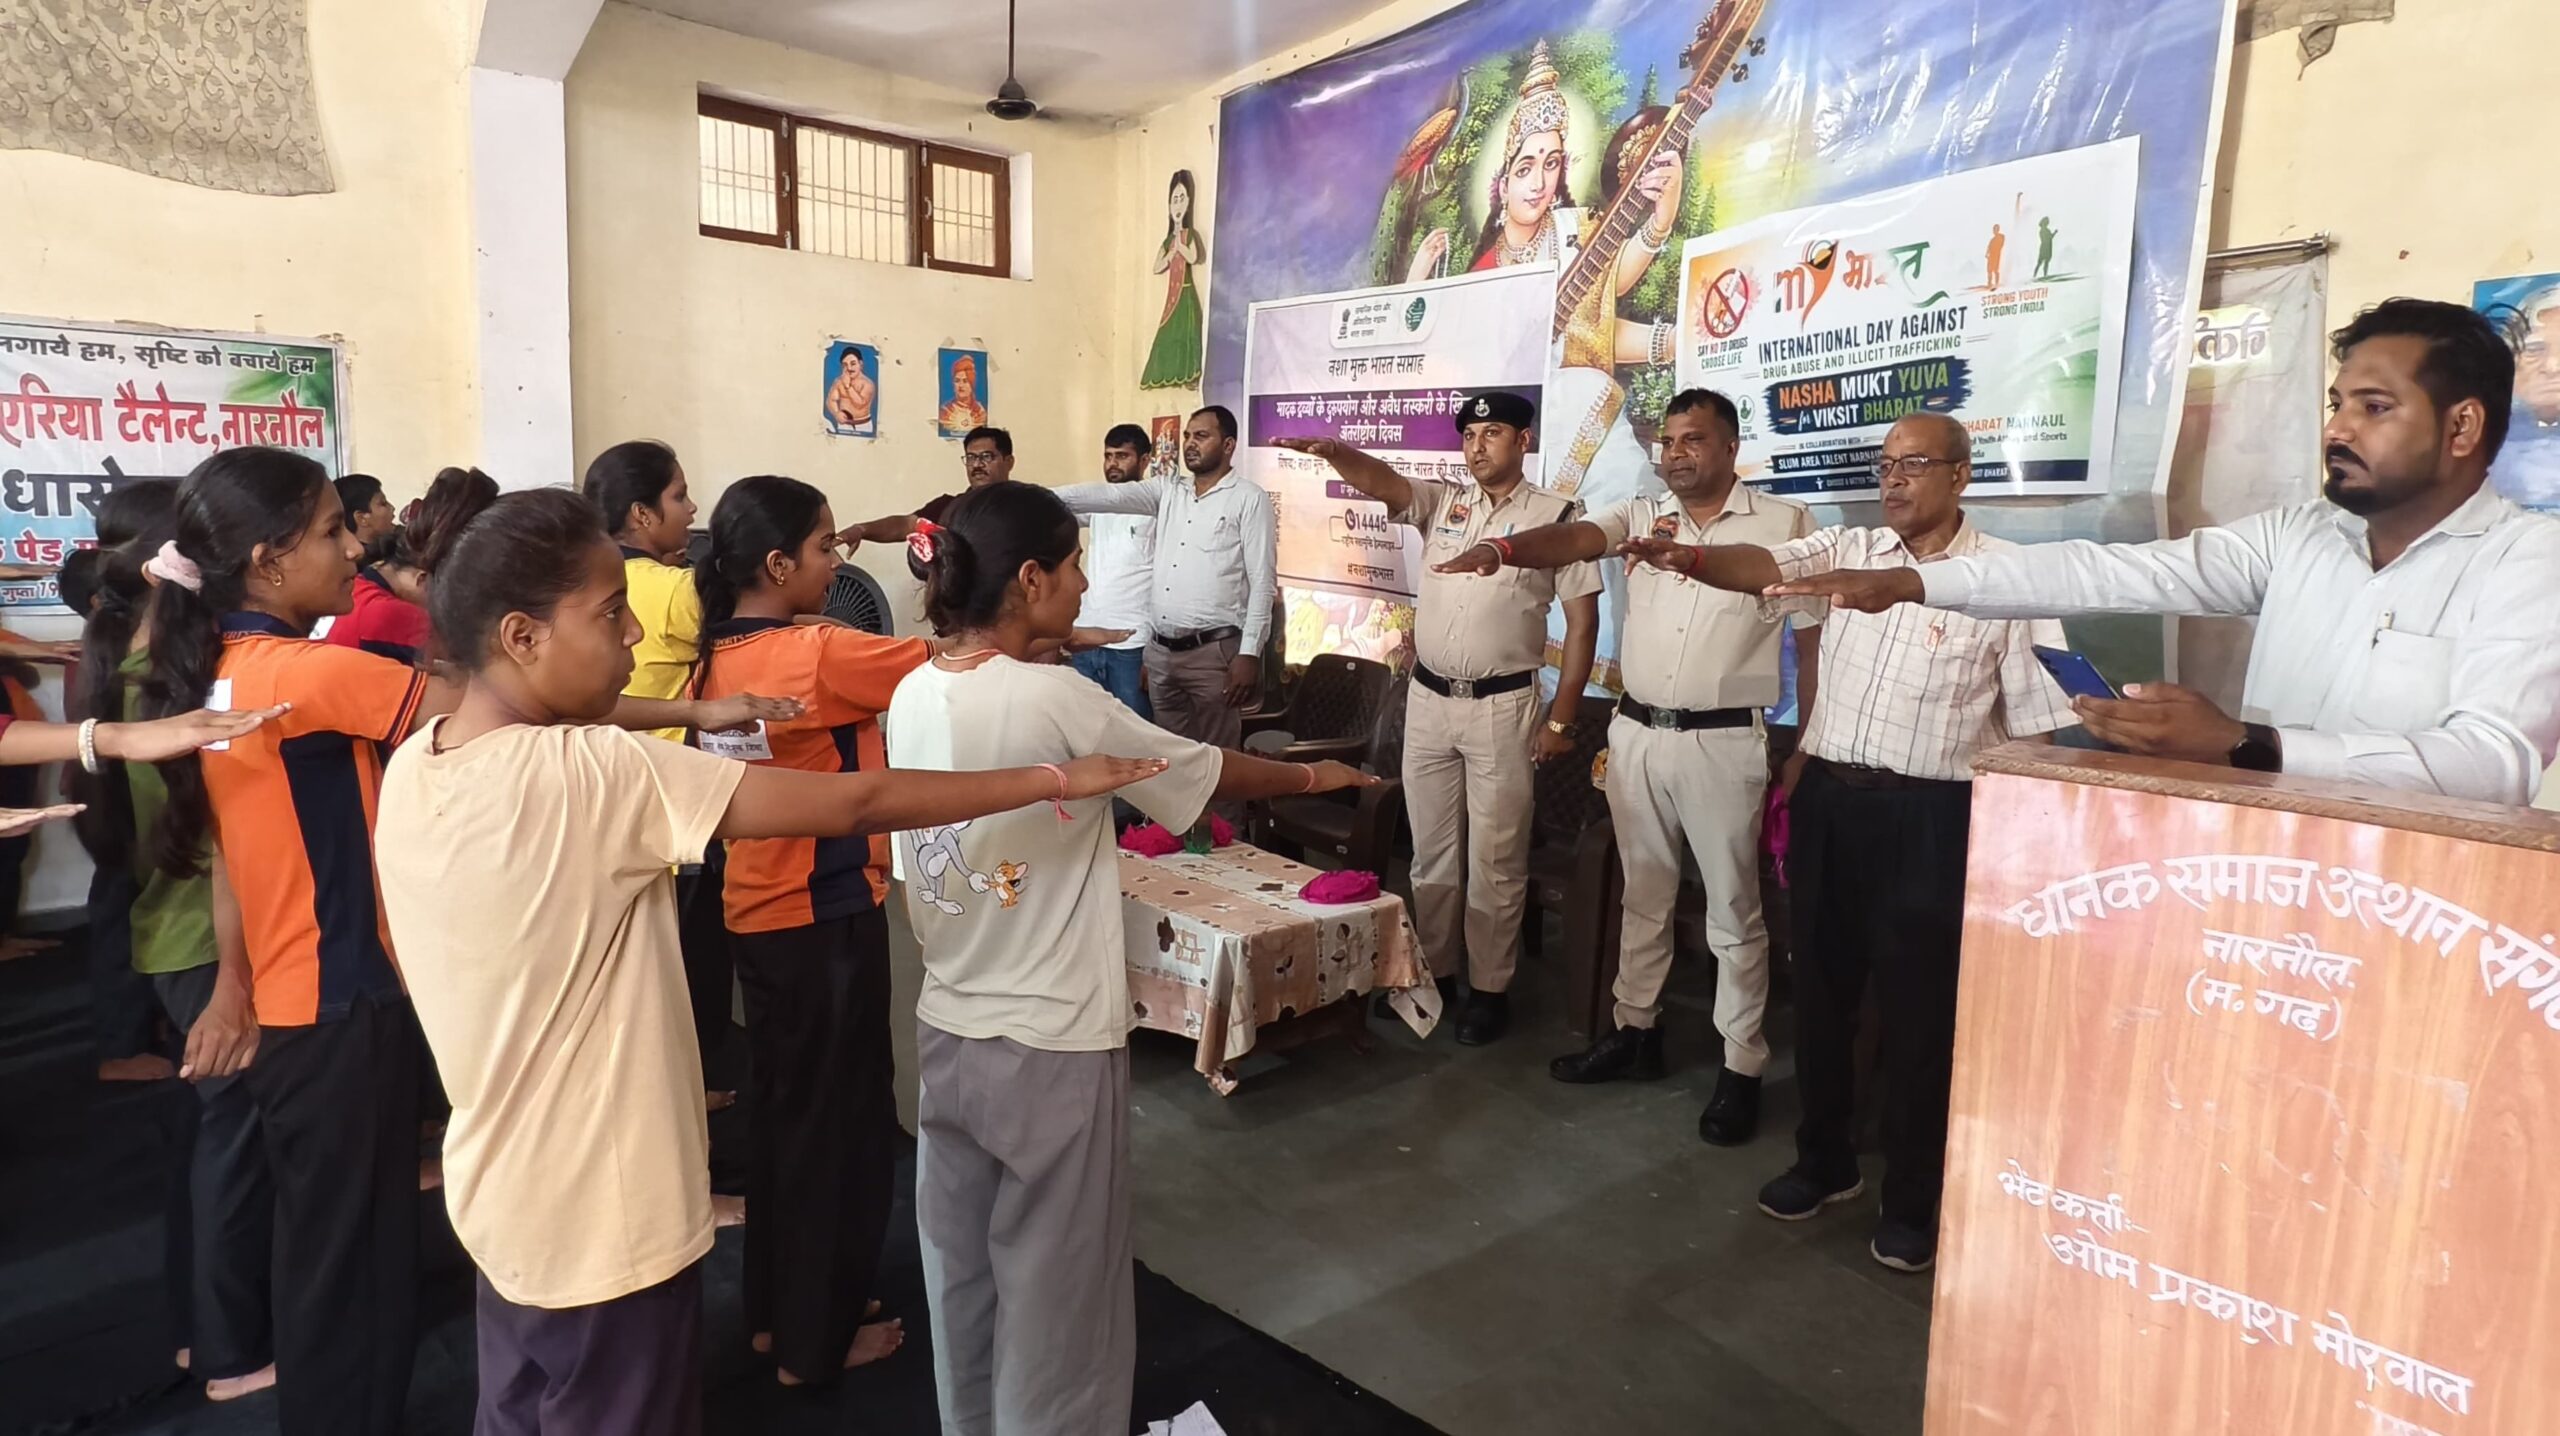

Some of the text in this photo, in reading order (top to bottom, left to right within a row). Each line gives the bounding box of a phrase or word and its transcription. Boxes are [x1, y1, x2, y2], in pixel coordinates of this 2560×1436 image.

[1981, 287, 2049, 307] STRONG YOUTH
[1983, 301, 2045, 319] STRONG INDIA
[1759, 306, 1968, 365] INTERNATIONAL DAY AGAINST
[134, 340, 188, 369] सृष्टि
[194, 345, 221, 366] को
[287, 356, 315, 375] हम
[1698, 345, 1708, 357] SAY
[1709, 342, 1719, 354] NO
[1720, 340, 1728, 352] TO
[1701, 350, 1742, 370] CHOOSE LIFE
[1763, 335, 1961, 380] DRUG ABUSE AND ILLICIT TRAFFICKING
[1350, 357, 1370, 381] मुक्त
[1371, 356, 1395, 375] भारत
[1779, 362, 1949, 410] NASHA MUKT YUVA
[1277, 401, 1296, 419] मादक
[1316, 394, 1325, 417] के
[1360, 391, 1378, 416] और
[1378, 391, 1402, 416] अवैध
[1402, 390, 1434, 416] तस्करी
[1435, 391, 1446, 414] के
[1813, 404, 1859, 428] VIKSIT
[1863, 395, 1924, 422] BHARAT
[1378, 419, 1403, 443] दिवस
[1962, 413, 2067, 433] HARAT NARNAUL
[2040, 431, 2067, 442] Sports
[1413, 461, 1434, 476] भारत
[1449, 463, 1473, 479] पहचा
[1778, 449, 1883, 470] SLUM AREA TALENT NARNAU
[1355, 513, 1388, 533] 14446
[2163, 854, 2321, 912] समाज
[2316, 866, 2490, 960] उत्थान
[2042, 1228, 2139, 1289] ओम
[2148, 1262, 2300, 1346] प्रकाश
